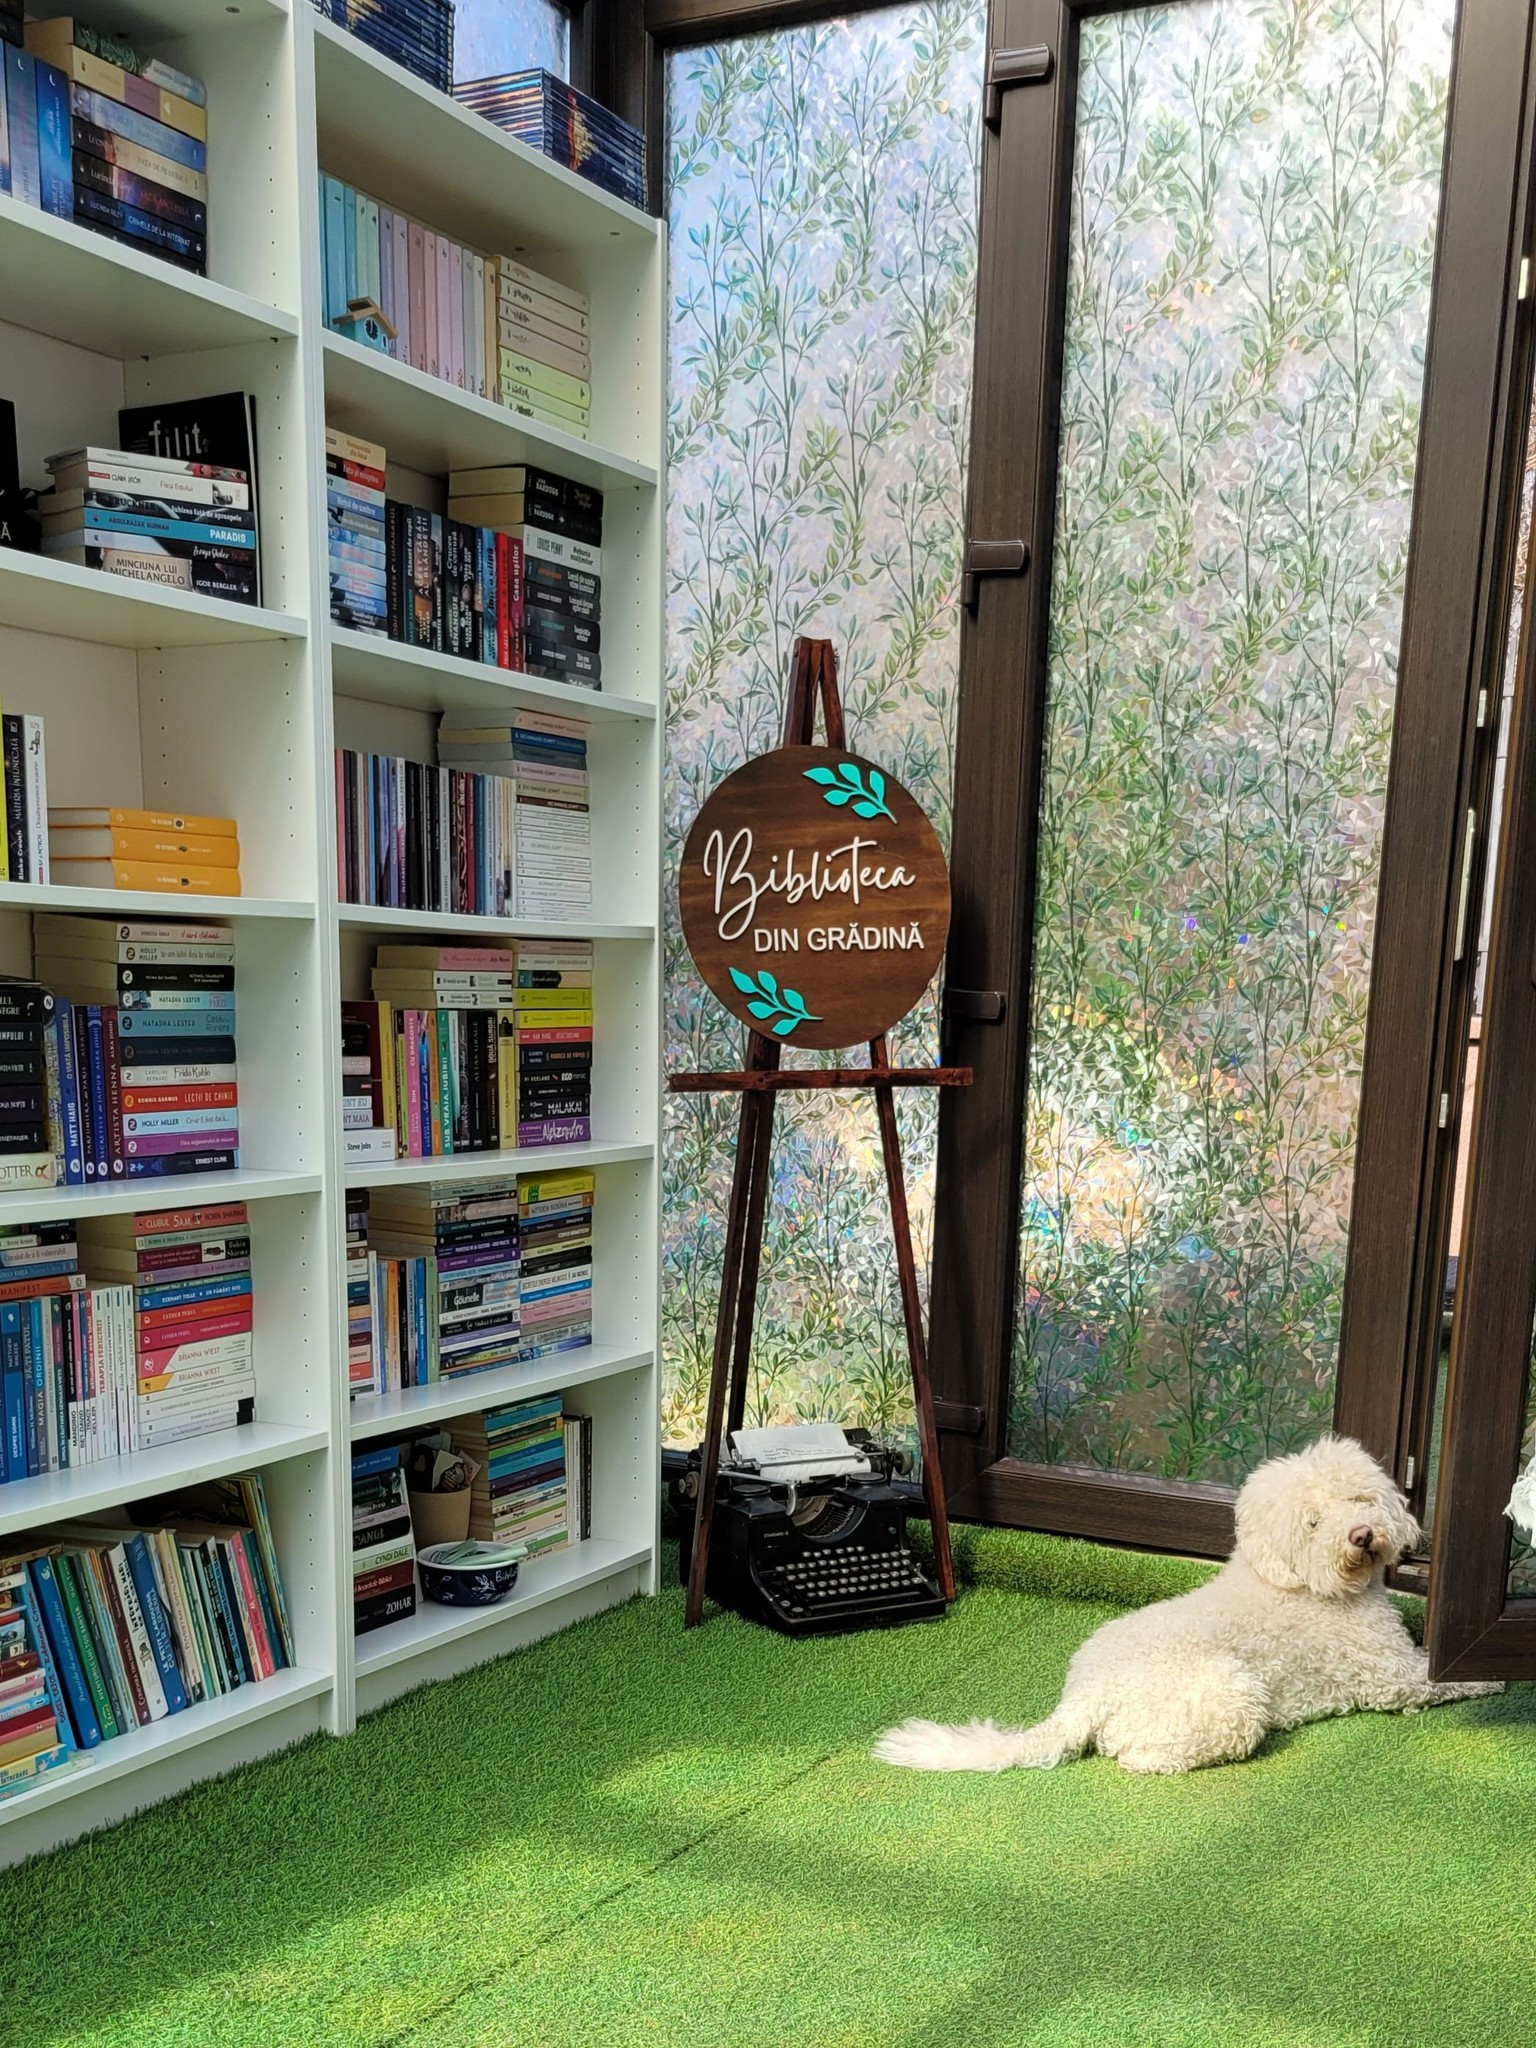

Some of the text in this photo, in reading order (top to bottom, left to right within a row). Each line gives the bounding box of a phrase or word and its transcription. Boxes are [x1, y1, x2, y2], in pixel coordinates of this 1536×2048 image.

[210, 529, 247, 543] PARADIS
[117, 558, 178, 574] MINCIUNA LUI
[110, 567, 186, 585] MICHELANGELO
[196, 580, 238, 591] IGOR BERGLER
[703, 827, 916, 941] Biblioteca
[754, 921, 925, 952] DIN GRĂDINĂ
[143, 1019, 196, 1027] NATASHA LESTER
[206, 1014, 221, 1024] Casa
[206, 1023, 230, 1032] Riviera
[410, 1056, 415, 1067] CU
[487, 1044, 495, 1064] DOUĂ
[174, 1067, 192, 1079] Frida
[441, 1056, 449, 1091] IUBIRII
[110, 1063, 118, 1104] HENNA
[204, 1093, 212, 1102] DE
[213, 1091, 233, 1101] CHIMIE
[67, 1102, 76, 1123] HAIG
[442, 1092, 450, 1127] VRAIA
[547, 1101, 582, 1115] MALAKAI
[112, 1107, 121, 1154] ARTISTA
[141, 1118, 180, 1128] HOLLY MILLER
[68, 1124, 78, 1147] MATT
[347, 1142, 372, 1152] Steve Jobs
[195, 1157, 213, 1165] ERNEST
[146, 1219, 169, 1228] CLUBUL
[222, 1209, 244, 1218] SHARMA
[229, 1240, 246, 1249] Robin
[227, 1249, 249, 1257] Sharma
[162, 1295, 182, 1303] ECKHART
[163, 1309, 196, 1320] ESTHER PEREL
[6, 1337, 14, 1367] MATTHEW
[96, 1319, 106, 1395] TERAPIA FERICIRII
[178, 1346, 220, 1361] BRIANNA WIEST
[178, 1366, 221, 1382] BRIANNA WIEST
[35, 1345, 45, 1426] MAGIA ORDINII
[374, 1547, 409, 1565] CYNDI DALE
[118, 1562, 127, 1583] MARI
[386, 1596, 412, 1615] ZOHAR
[145, 1591, 171, 1674] LE PETIT LAROUSSE
[83, 1634, 92, 1648] TOM
[87, 1649, 95, 1660] LUI
[128, 1661, 137, 1673] DIN
[88, 1661, 105, 1700] AVENTURILE
[130, 1674, 146, 1706] COMOARA
